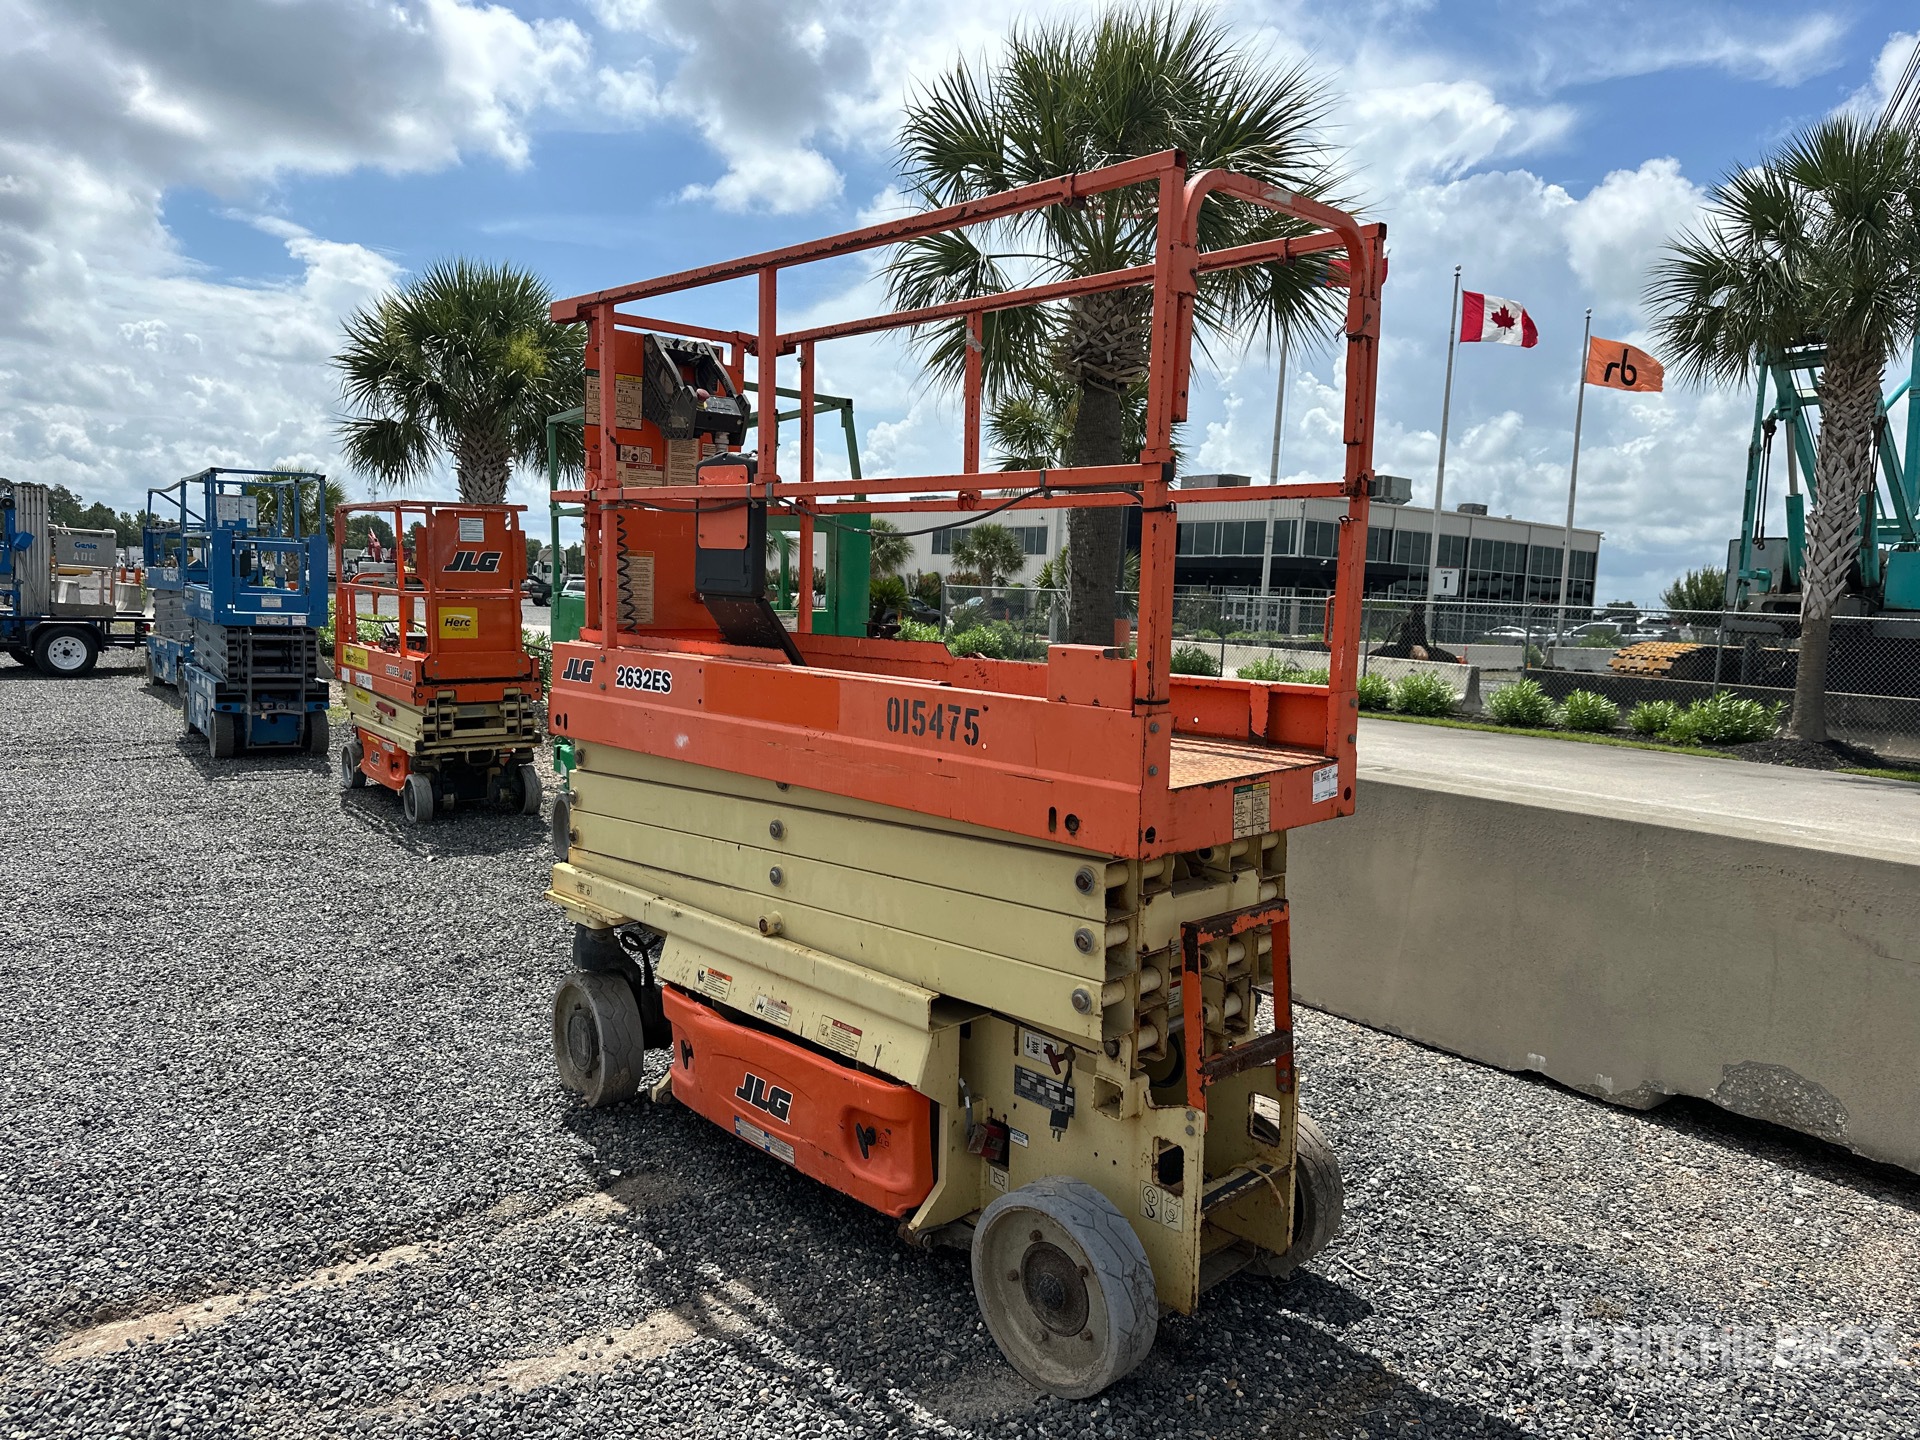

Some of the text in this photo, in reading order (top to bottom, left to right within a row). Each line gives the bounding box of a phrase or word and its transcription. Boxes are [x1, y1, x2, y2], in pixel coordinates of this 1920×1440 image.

[604, 349, 637, 386] rb
[74, 541, 97, 550] Genie
[442, 550, 503, 573] JLG
[1442, 576, 1449, 589] 1
[444, 617, 471, 627] Herc
[561, 657, 673, 695] JLG 2632ES
[886, 696, 980, 746] 015475
[734, 1071, 794, 1124] JLG
